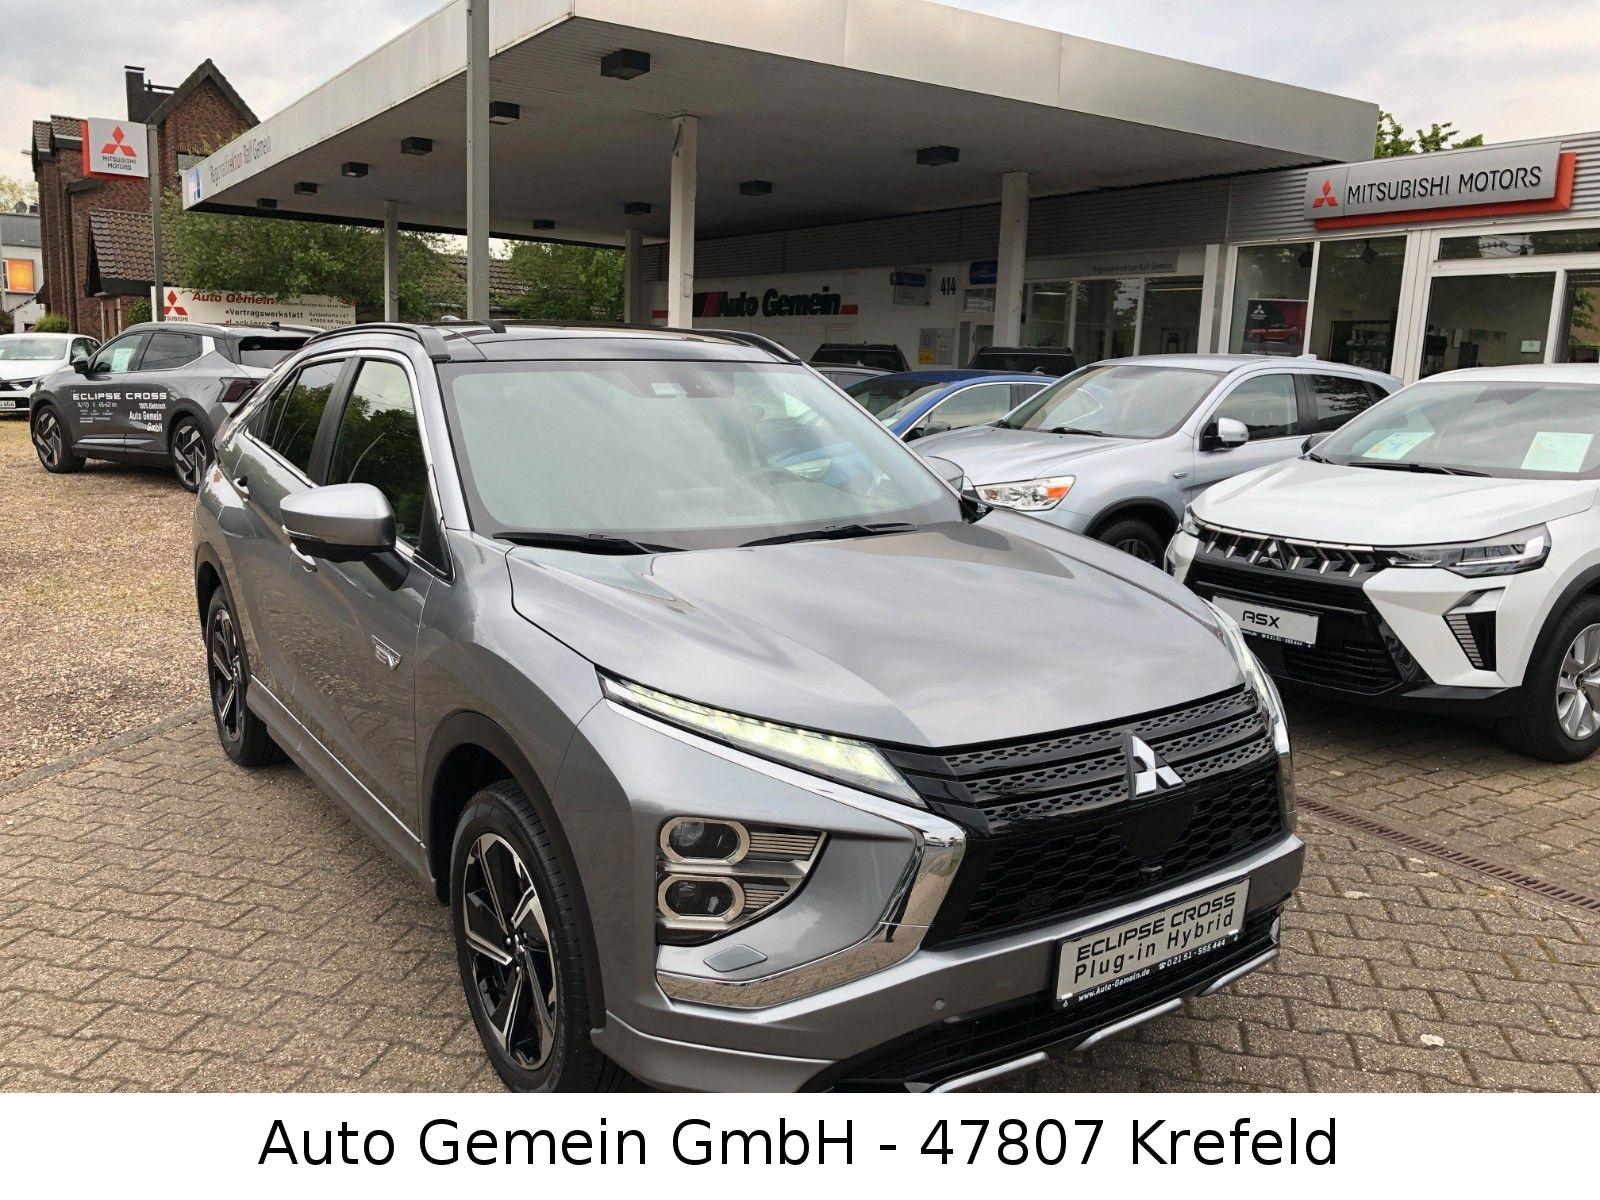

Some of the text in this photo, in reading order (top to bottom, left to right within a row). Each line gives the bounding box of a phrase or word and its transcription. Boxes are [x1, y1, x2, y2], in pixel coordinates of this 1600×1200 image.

[102, 156, 136, 164] MITSUBISHI
[1348, 166, 1542, 204] MITSUBISHI MOTORS
[940, 276, 956, 296] 414
[192, 292, 222, 303] Auto
[226, 292, 274, 305] Gemein
[719, 286, 841, 317] Auto Gemein
[230, 308, 303, 318] Vertragswerkstatt
[129, 411, 162, 420] Auto Gemein
[146, 422, 162, 432] GmbH
[1243, 610, 1280, 628] ASX
[1076, 892, 1236, 962] ECLIPSE CROSS
[1074, 909, 1233, 984] Plug-in Hybrid
[1078, 968, 1150, 1002] www.Auto-Gemein.de
